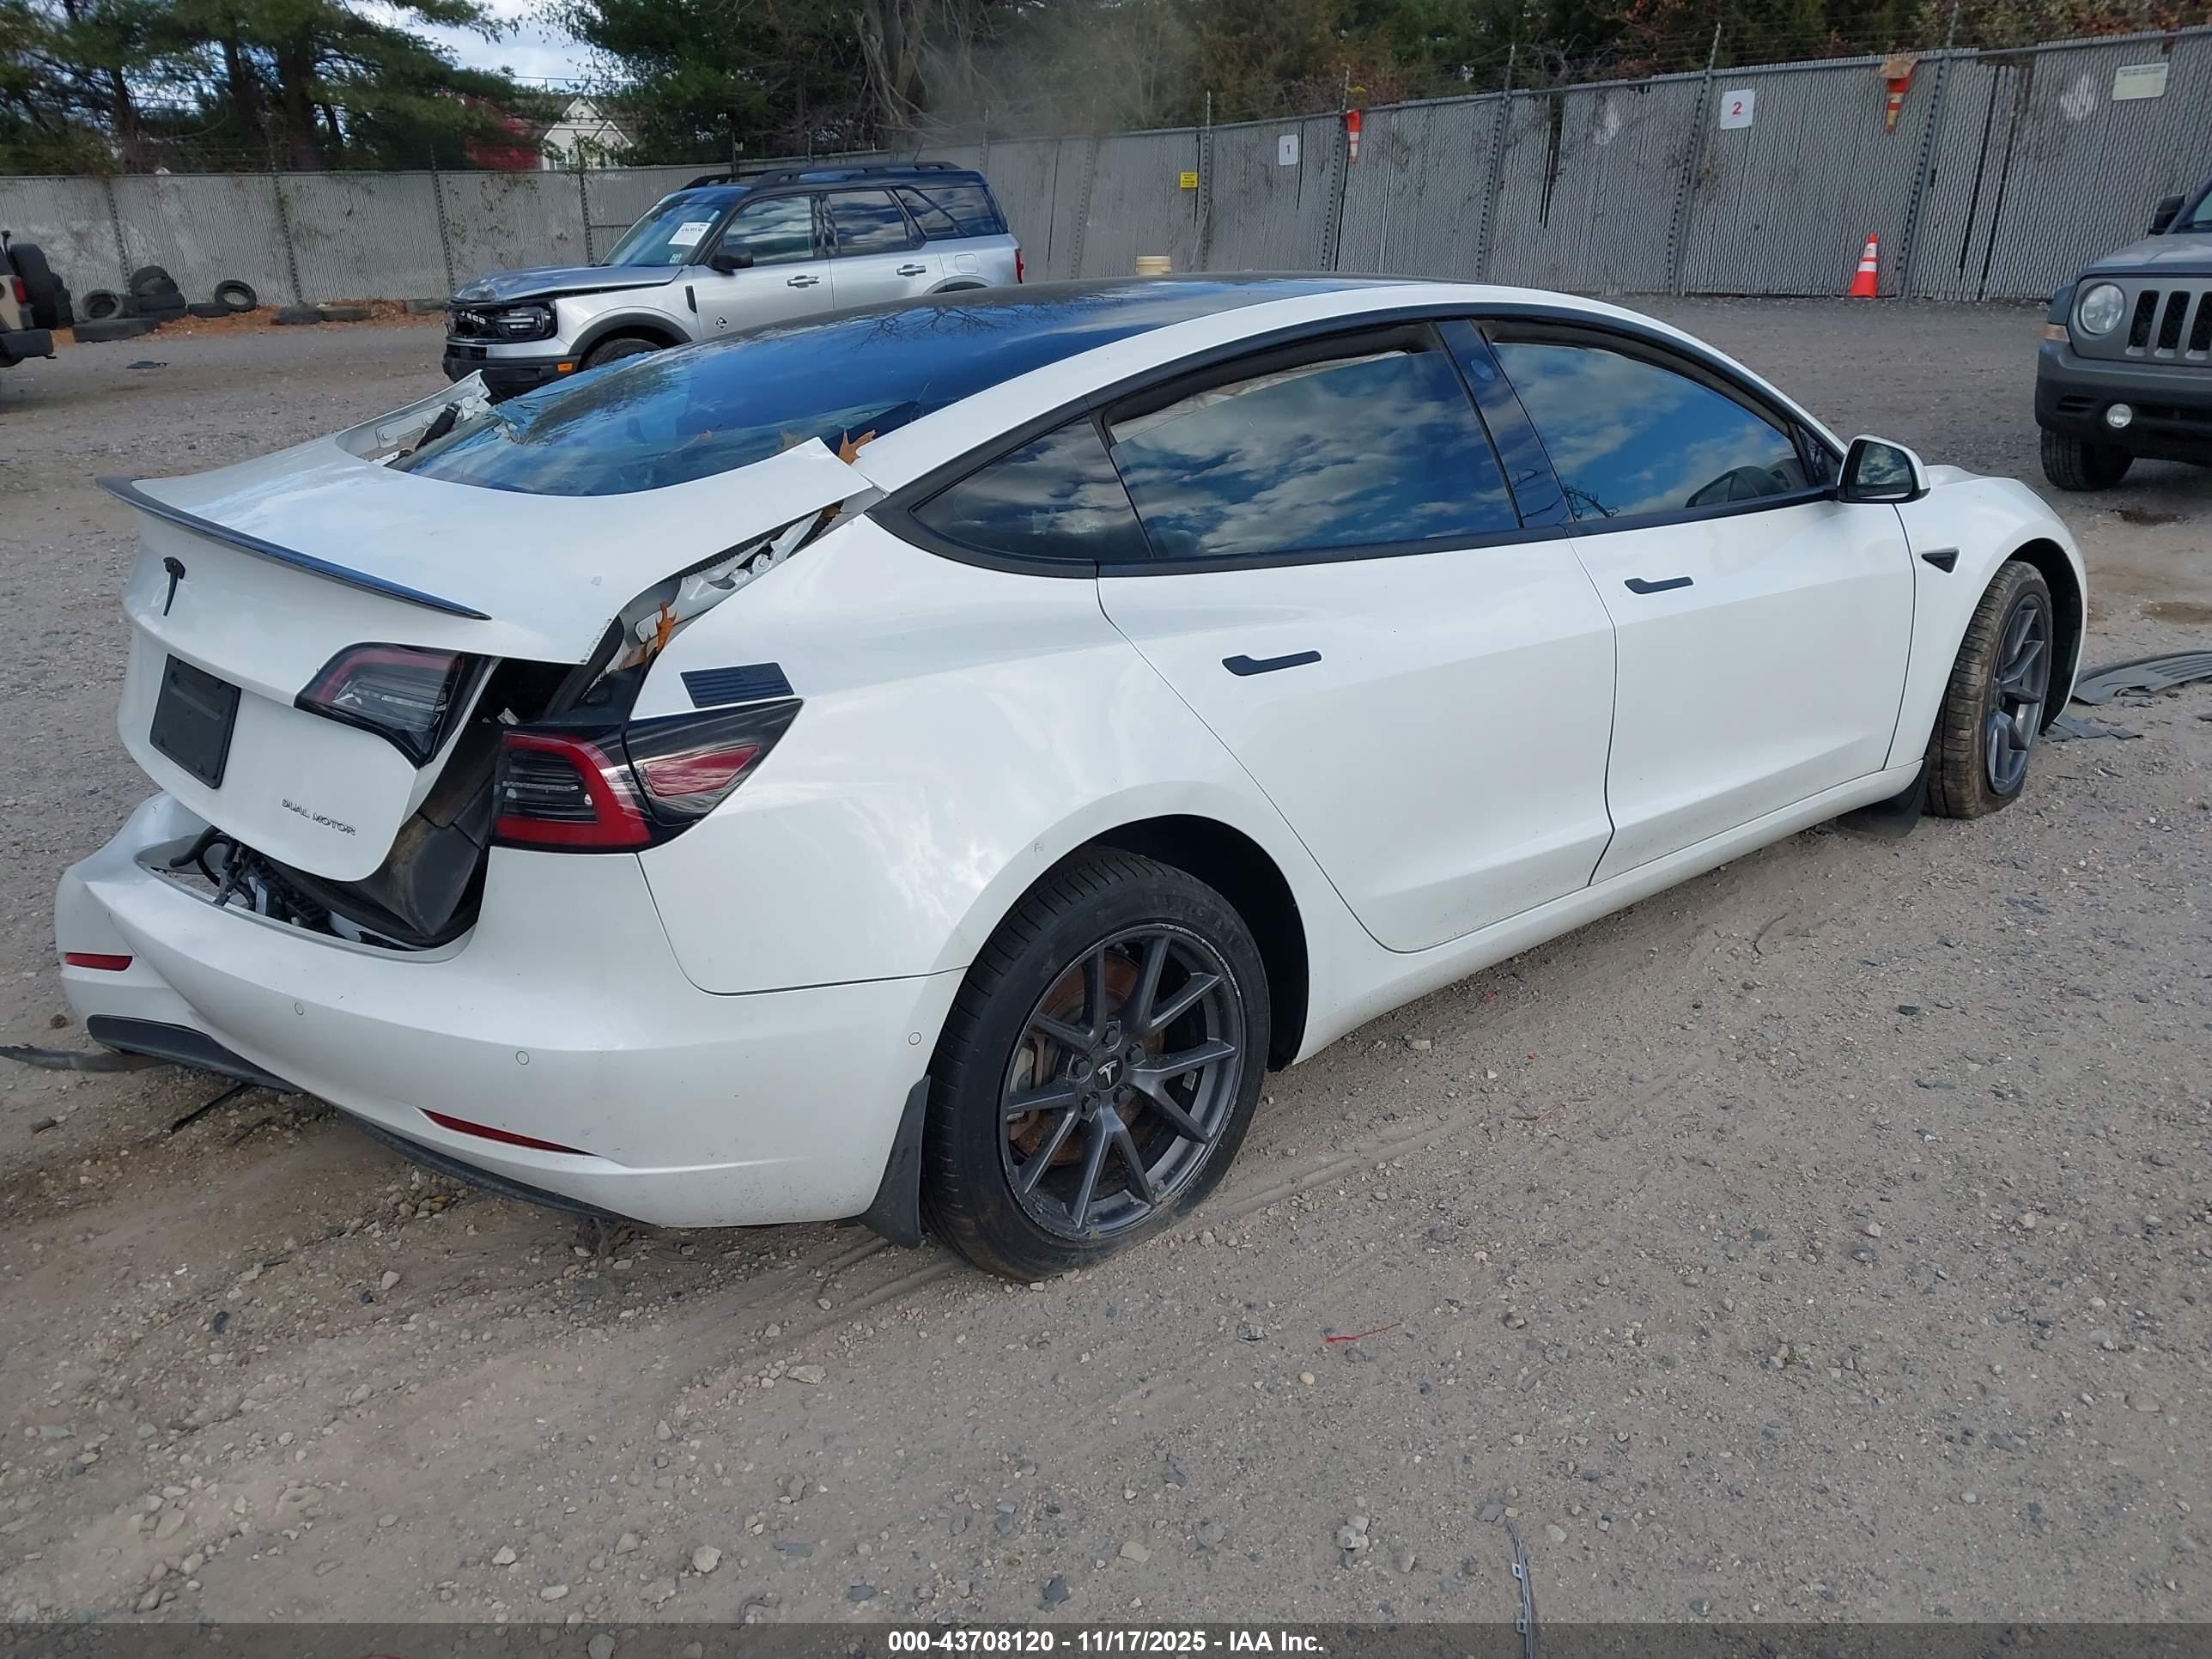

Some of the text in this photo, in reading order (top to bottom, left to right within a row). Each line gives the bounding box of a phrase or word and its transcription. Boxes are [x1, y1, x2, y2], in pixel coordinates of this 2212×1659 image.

[1732, 101, 1742, 115] 2
[1285, 143, 1291, 155] 1
[282, 799, 356, 836] DUAL MOTOR
